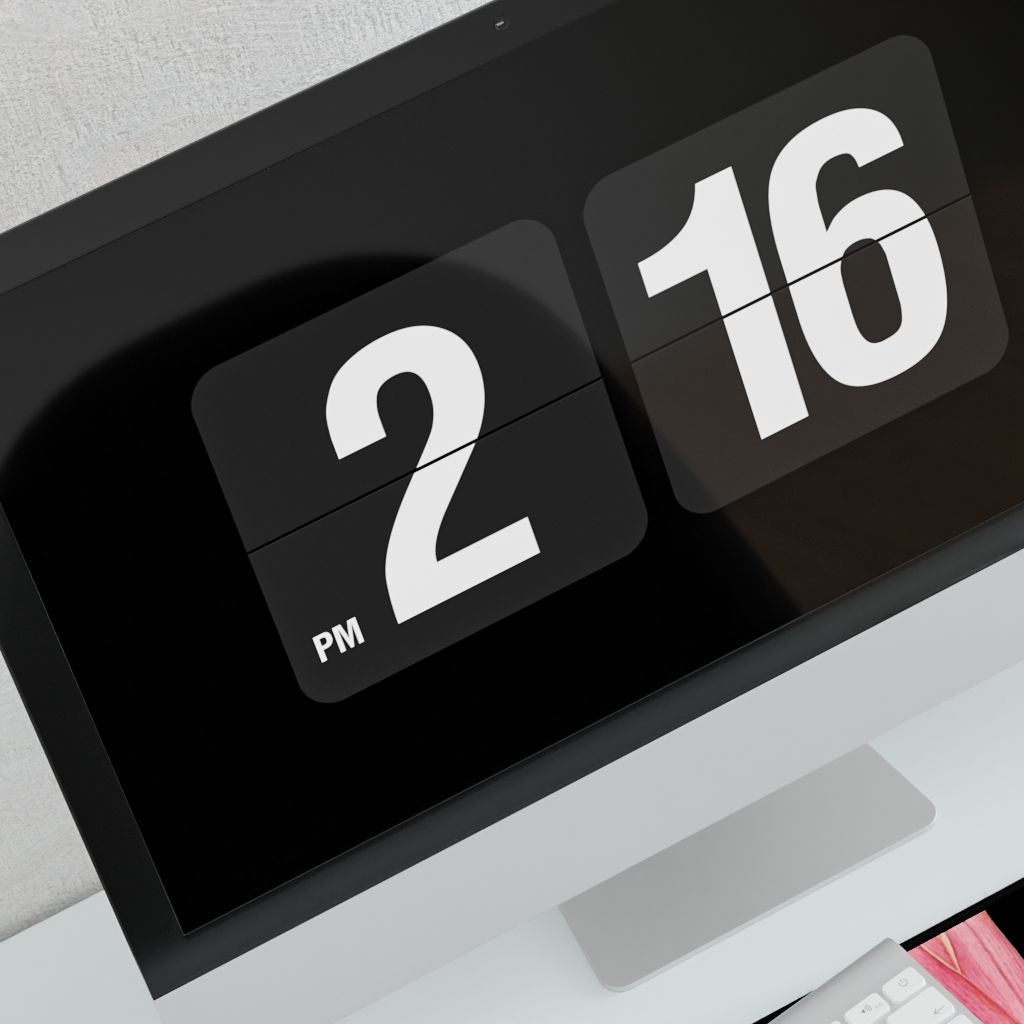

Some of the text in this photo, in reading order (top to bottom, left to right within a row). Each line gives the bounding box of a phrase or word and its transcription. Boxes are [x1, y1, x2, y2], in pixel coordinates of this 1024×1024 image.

[324, 107, 948, 625] 2 16
[312, 616, 365, 664] PM
